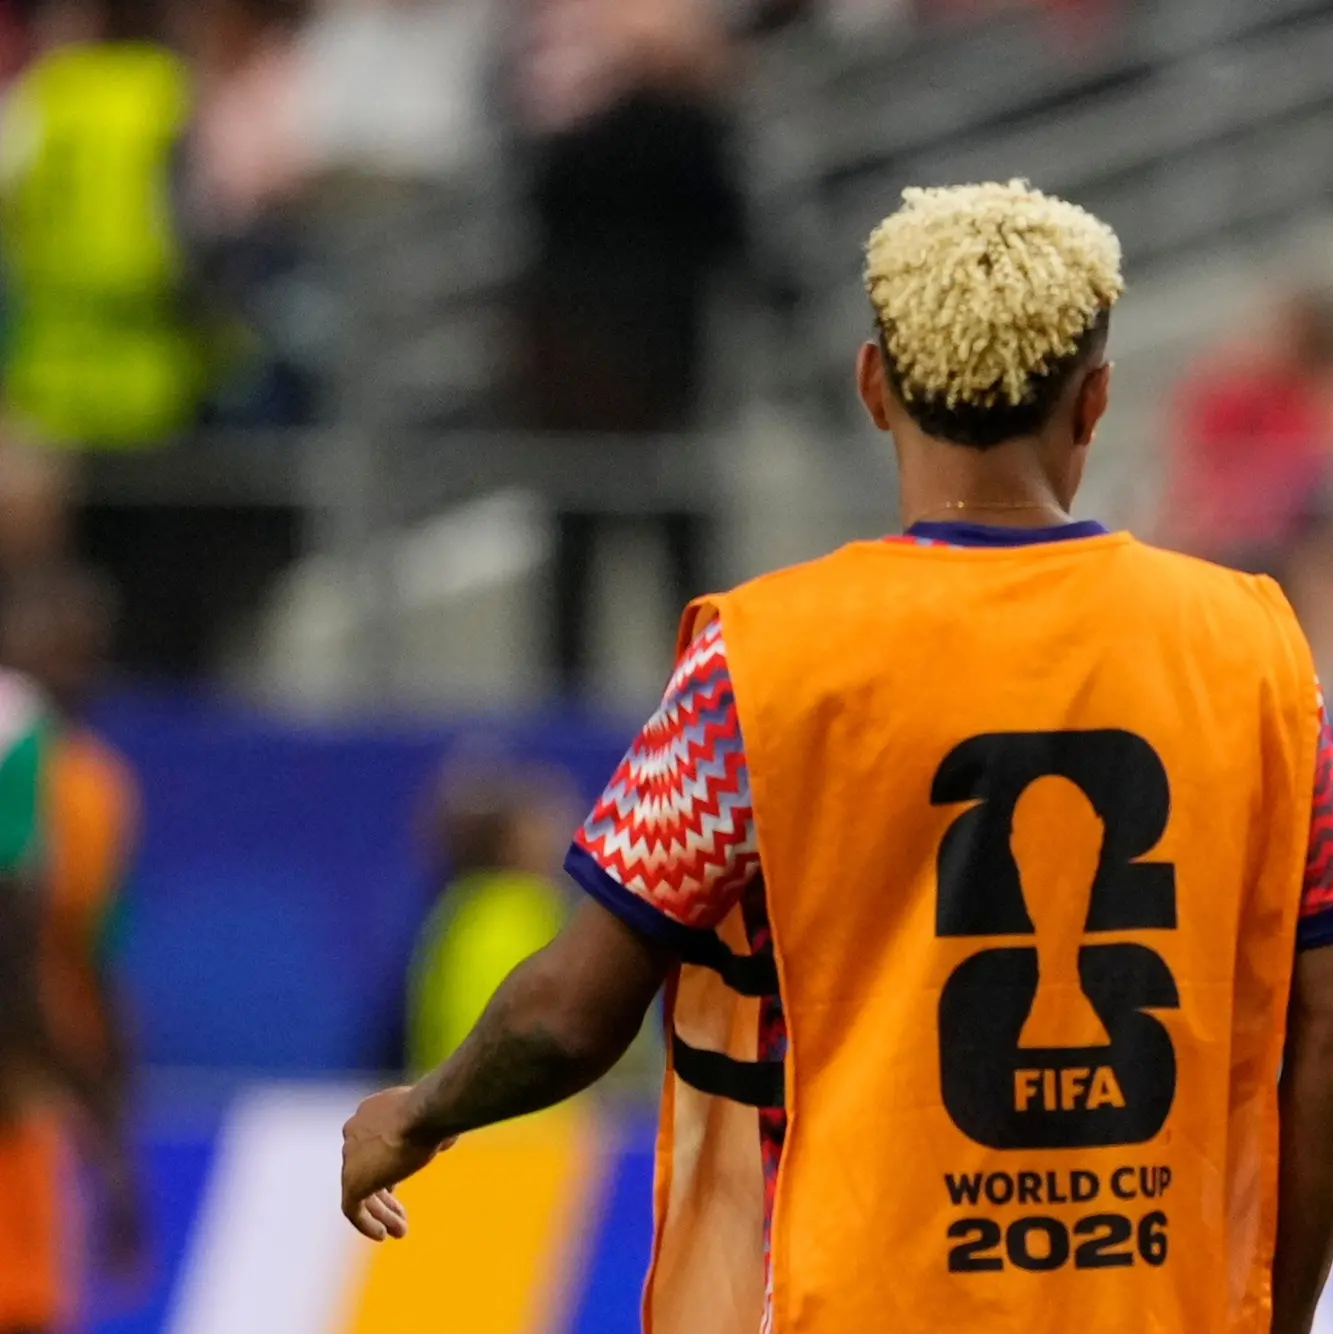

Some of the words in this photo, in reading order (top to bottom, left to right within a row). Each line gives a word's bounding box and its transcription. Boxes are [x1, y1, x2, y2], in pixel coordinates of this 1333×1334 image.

[1014, 1066, 1126, 1111] FIFA
[944, 1169, 1100, 1206] WORLD
[1110, 1166, 1172, 1200] CUP
[947, 1210, 1169, 1273] 2026
